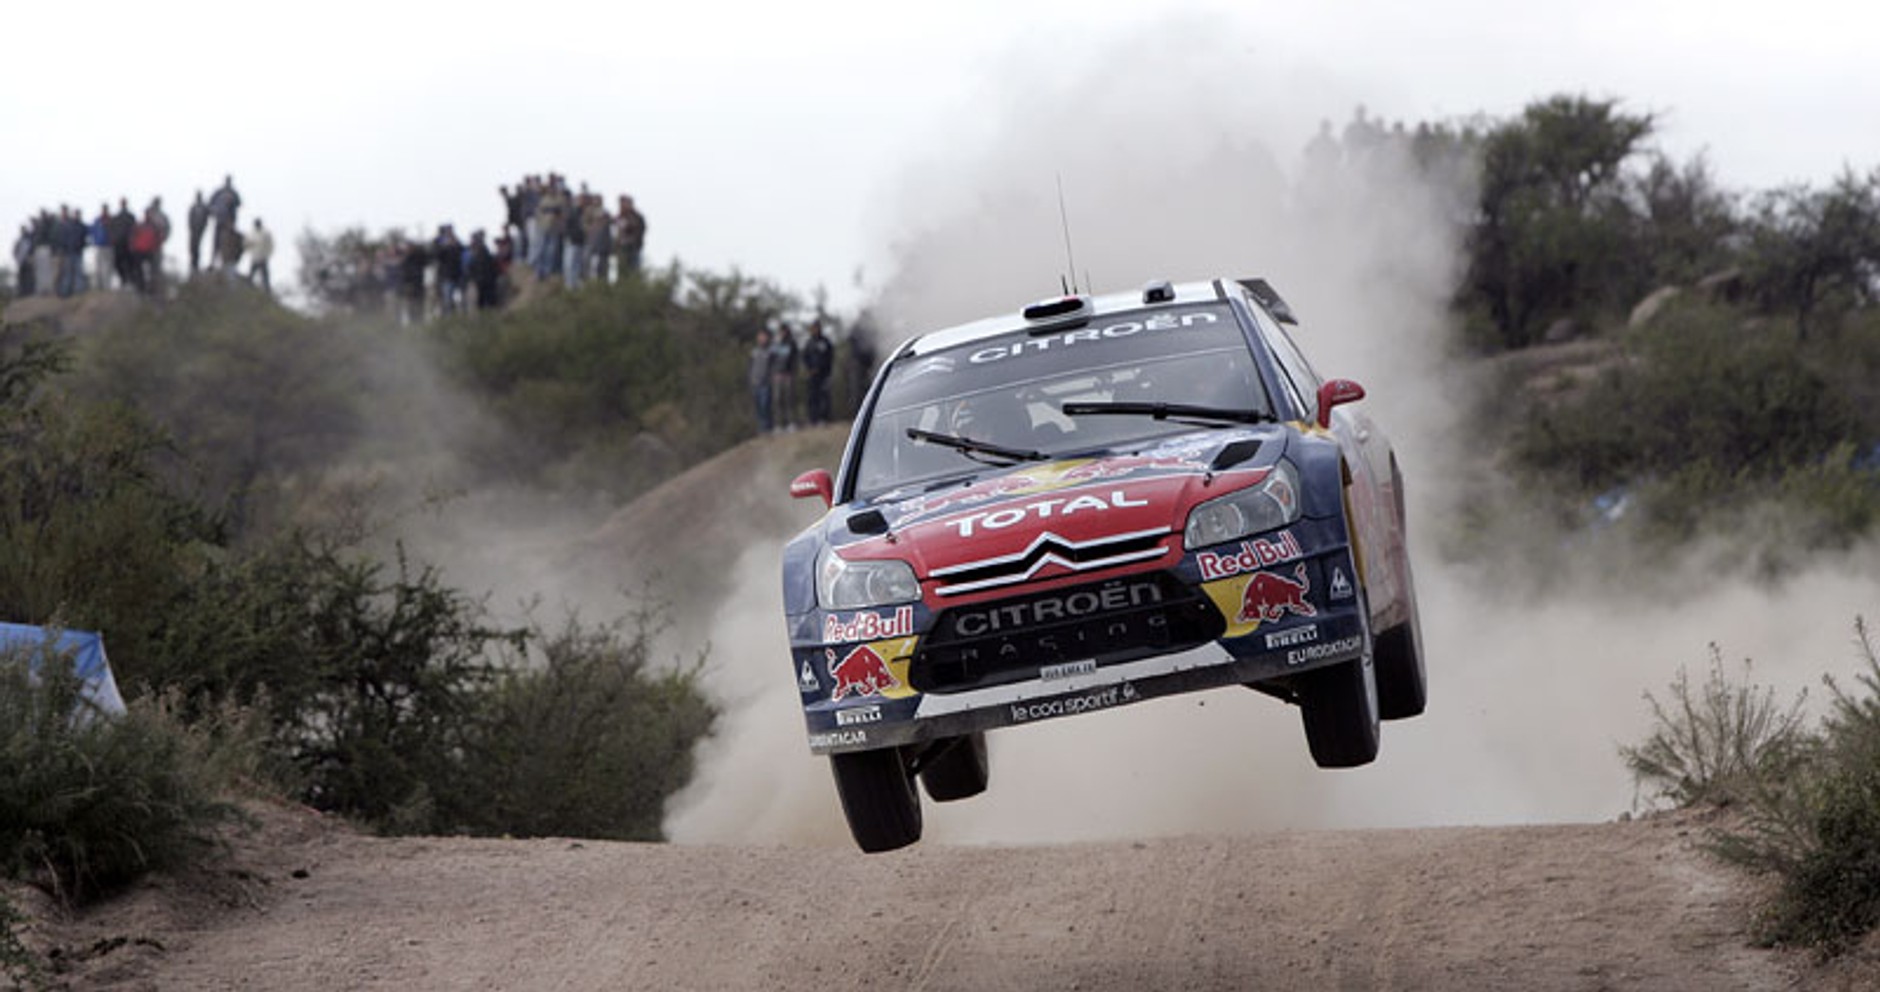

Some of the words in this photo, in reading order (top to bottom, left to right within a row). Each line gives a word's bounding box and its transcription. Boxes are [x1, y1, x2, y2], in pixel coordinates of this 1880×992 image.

[949, 490, 1148, 537] TOTAL
[1196, 540, 1259, 581] Red
[1254, 529, 1303, 568] Bull
[823, 612, 861, 644] Red
[860, 605, 914, 639] Bull
[1264, 624, 1318, 650] PIRELLI
[836, 706, 883, 726] PIRELLI
[1010, 704, 1028, 721] le
